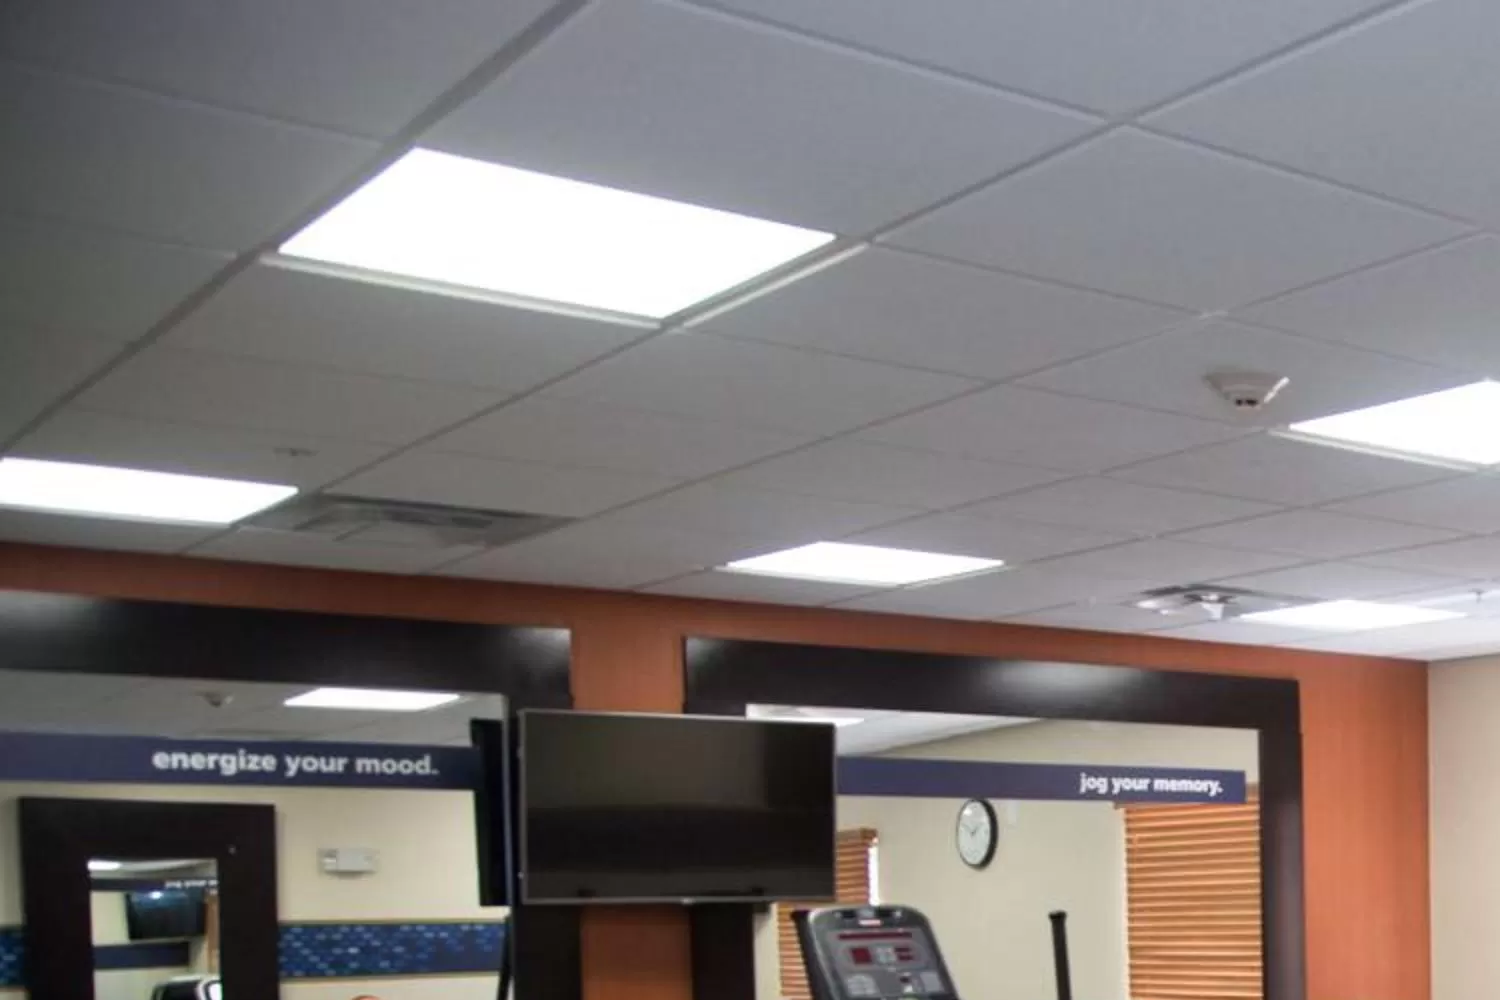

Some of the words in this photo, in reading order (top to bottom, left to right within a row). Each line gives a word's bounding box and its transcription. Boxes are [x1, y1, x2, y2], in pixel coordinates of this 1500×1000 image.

[153, 748, 277, 776] energize
[284, 752, 349, 777] your
[355, 754, 440, 775] mood.
[1079, 772, 1108, 794] jog
[1112, 776, 1150, 796] your
[1153, 778, 1224, 797] memory.
